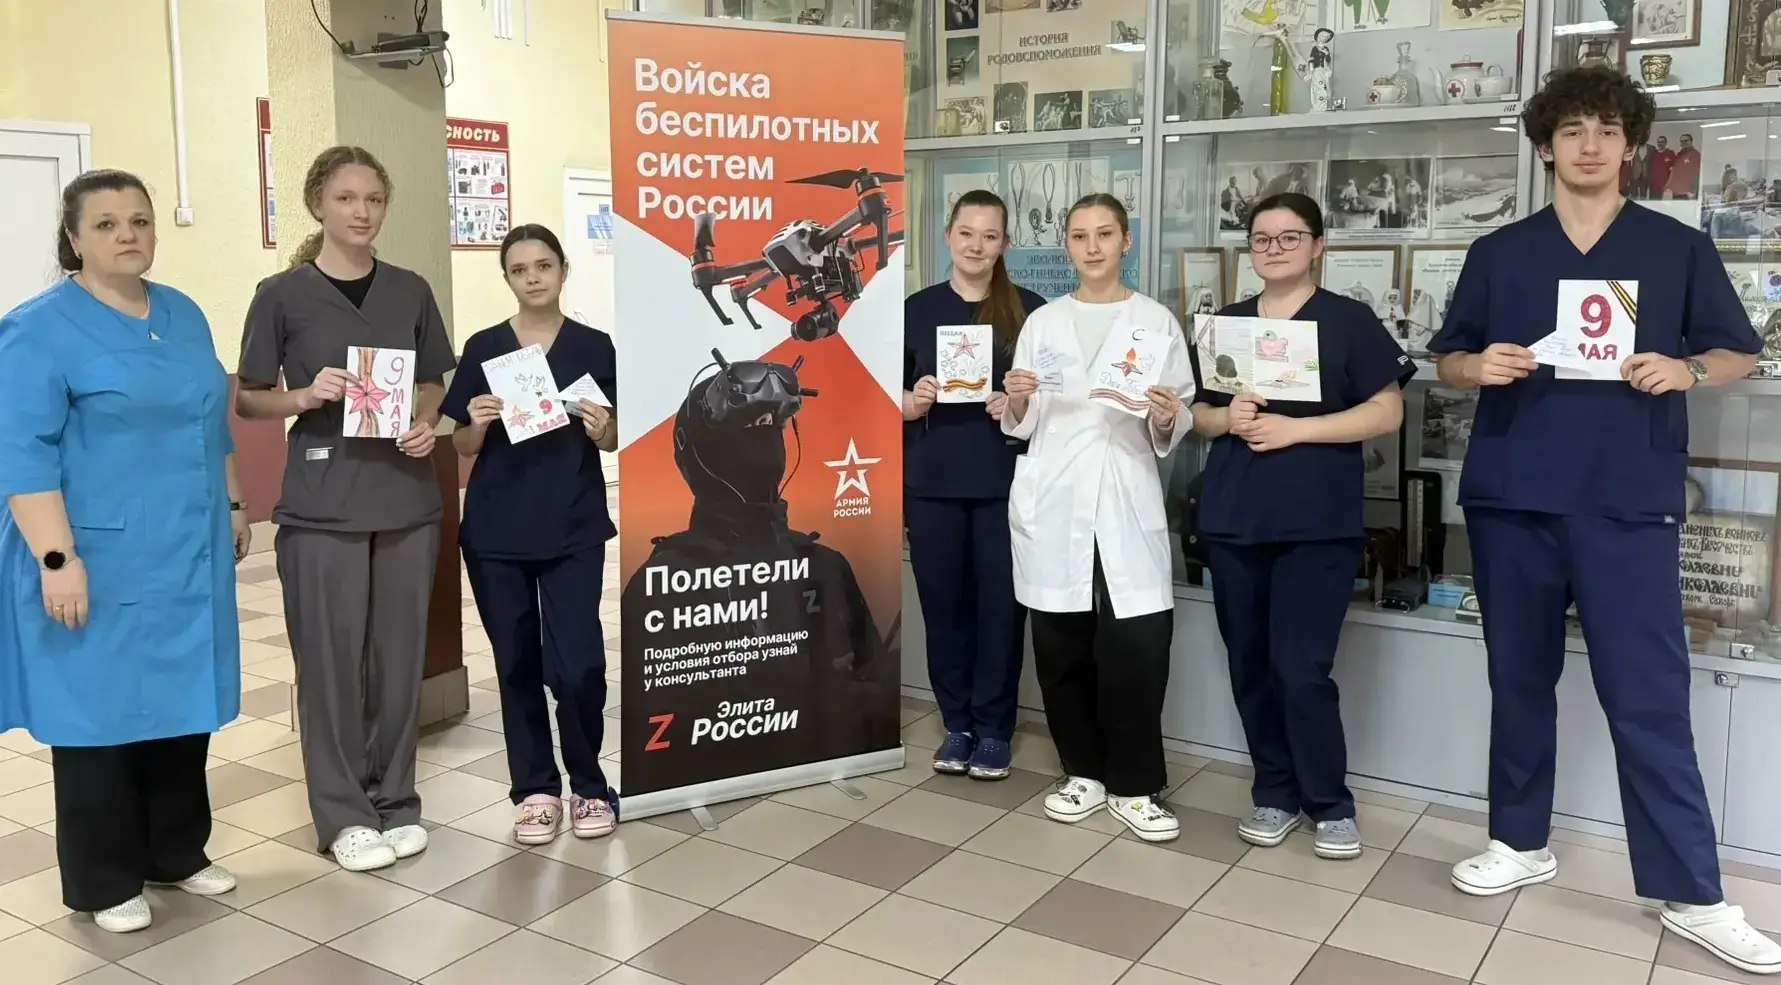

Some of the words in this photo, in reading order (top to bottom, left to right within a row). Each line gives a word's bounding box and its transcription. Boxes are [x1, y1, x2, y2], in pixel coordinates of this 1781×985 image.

[1019, 32, 1069, 47] ИСТОРИЯ
[634, 58, 770, 98] Войска
[635, 101, 880, 144] беспилотных
[636, 151, 774, 180] систем
[638, 186, 773, 220] России
[1580, 294, 1612, 338] 9
[384, 357, 405, 385] 9
[390, 388, 404, 437] МАЯ
[540, 399, 553, 415] 9
[833, 507, 872, 518] РОССИИ
[836, 497, 869, 507] АРМИЯ
[645, 557, 810, 596] Полетели
[644, 611, 664, 633] с
[673, 591, 768, 630] нами!
[644, 641, 722, 661] Подробную
[725, 630, 809, 649] информацию
[644, 665, 652, 675] и
[655, 656, 710, 676] условия
[713, 650, 759, 666] отбора
[762, 643, 798, 661] узнай
[644, 679, 652, 692] у
[655, 665, 747, 688] консультанта
[717, 697, 775, 719] Элита
[644, 713, 674, 751] Z
[691, 709, 799, 745] России
